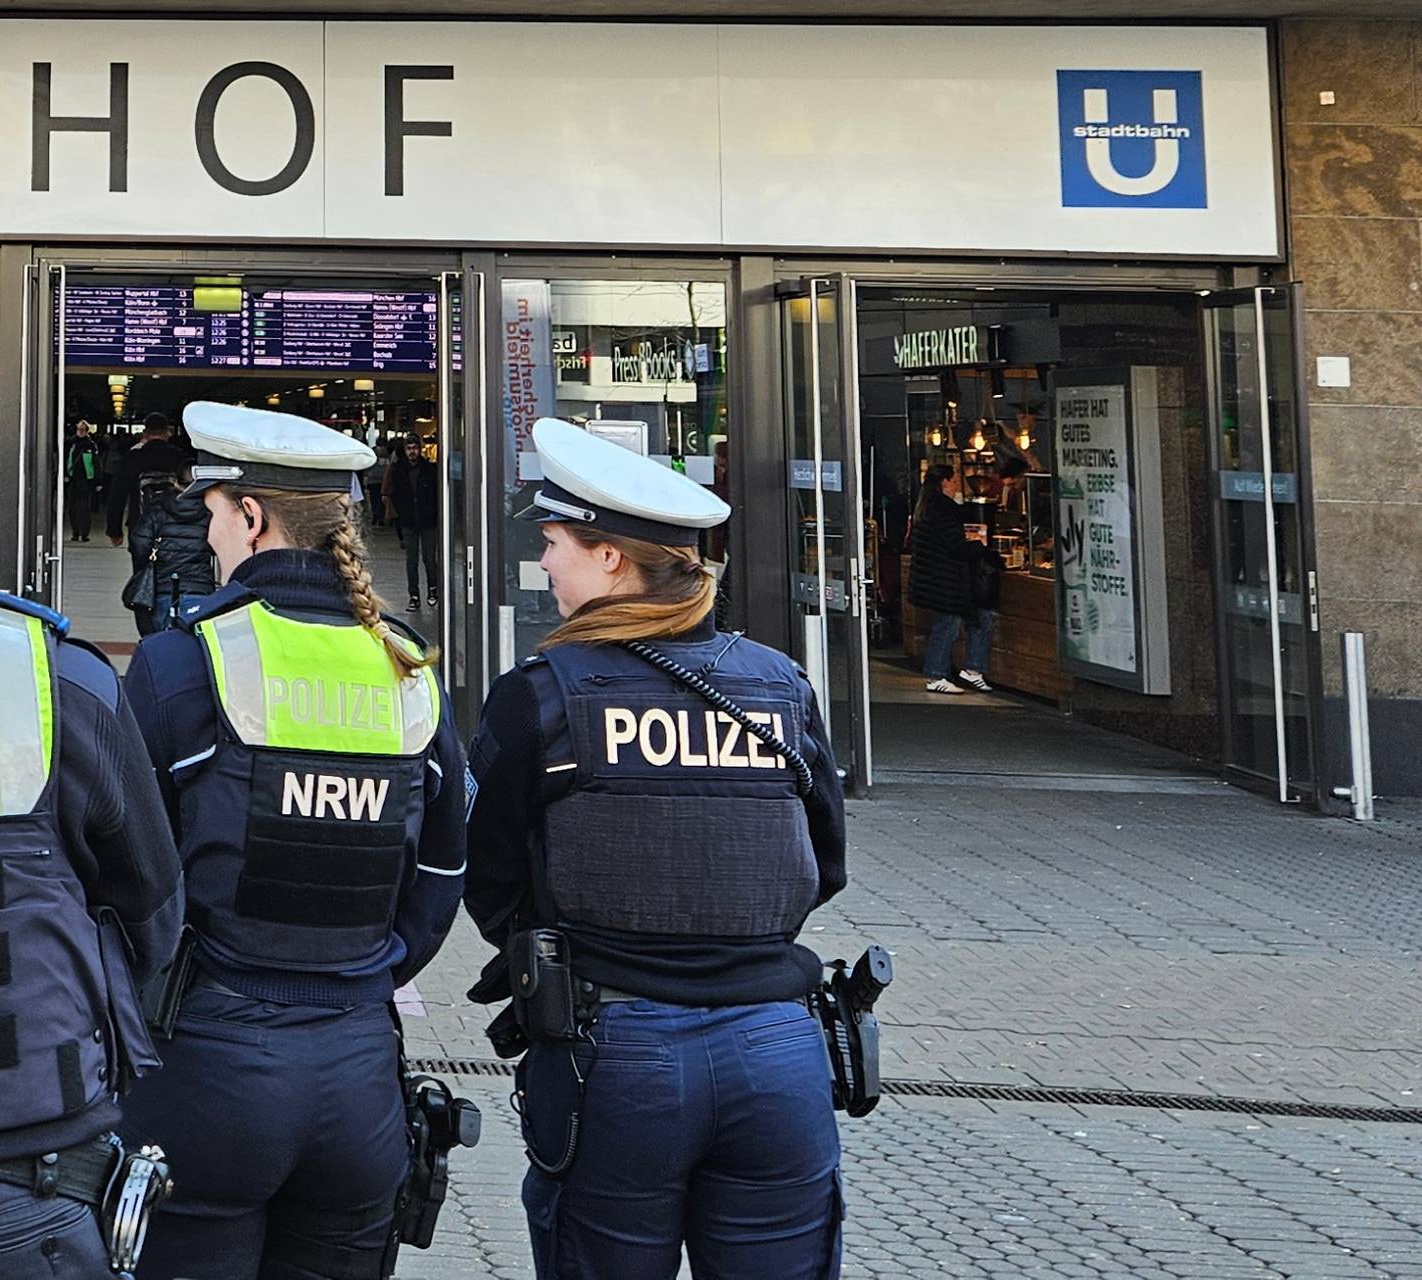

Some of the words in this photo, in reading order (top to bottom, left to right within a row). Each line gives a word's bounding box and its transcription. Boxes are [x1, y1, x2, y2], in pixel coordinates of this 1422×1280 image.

[1073, 124, 1191, 138] stadtbahn
[1083, 88, 1180, 196] U
[903, 325, 978, 369] HAFERKATER
[1060, 399, 1089, 419] HAFER
[1090, 398, 1108, 418] HAT
[1061, 423, 1091, 443] GUTES
[1062, 448, 1119, 469] MARKETING.
[1087, 473, 1116, 493] ERBSE
[1088, 499, 1105, 518] HAT
[1089, 522, 1114, 545] GUTE
[1090, 544, 1121, 570] NÄHR-
[1091, 573, 1129, 597] STOFFE.
[267, 675, 401, 732] POLIZEI
[604, 707, 786, 769] POLIZEI
[281, 771, 390, 822] NRW
